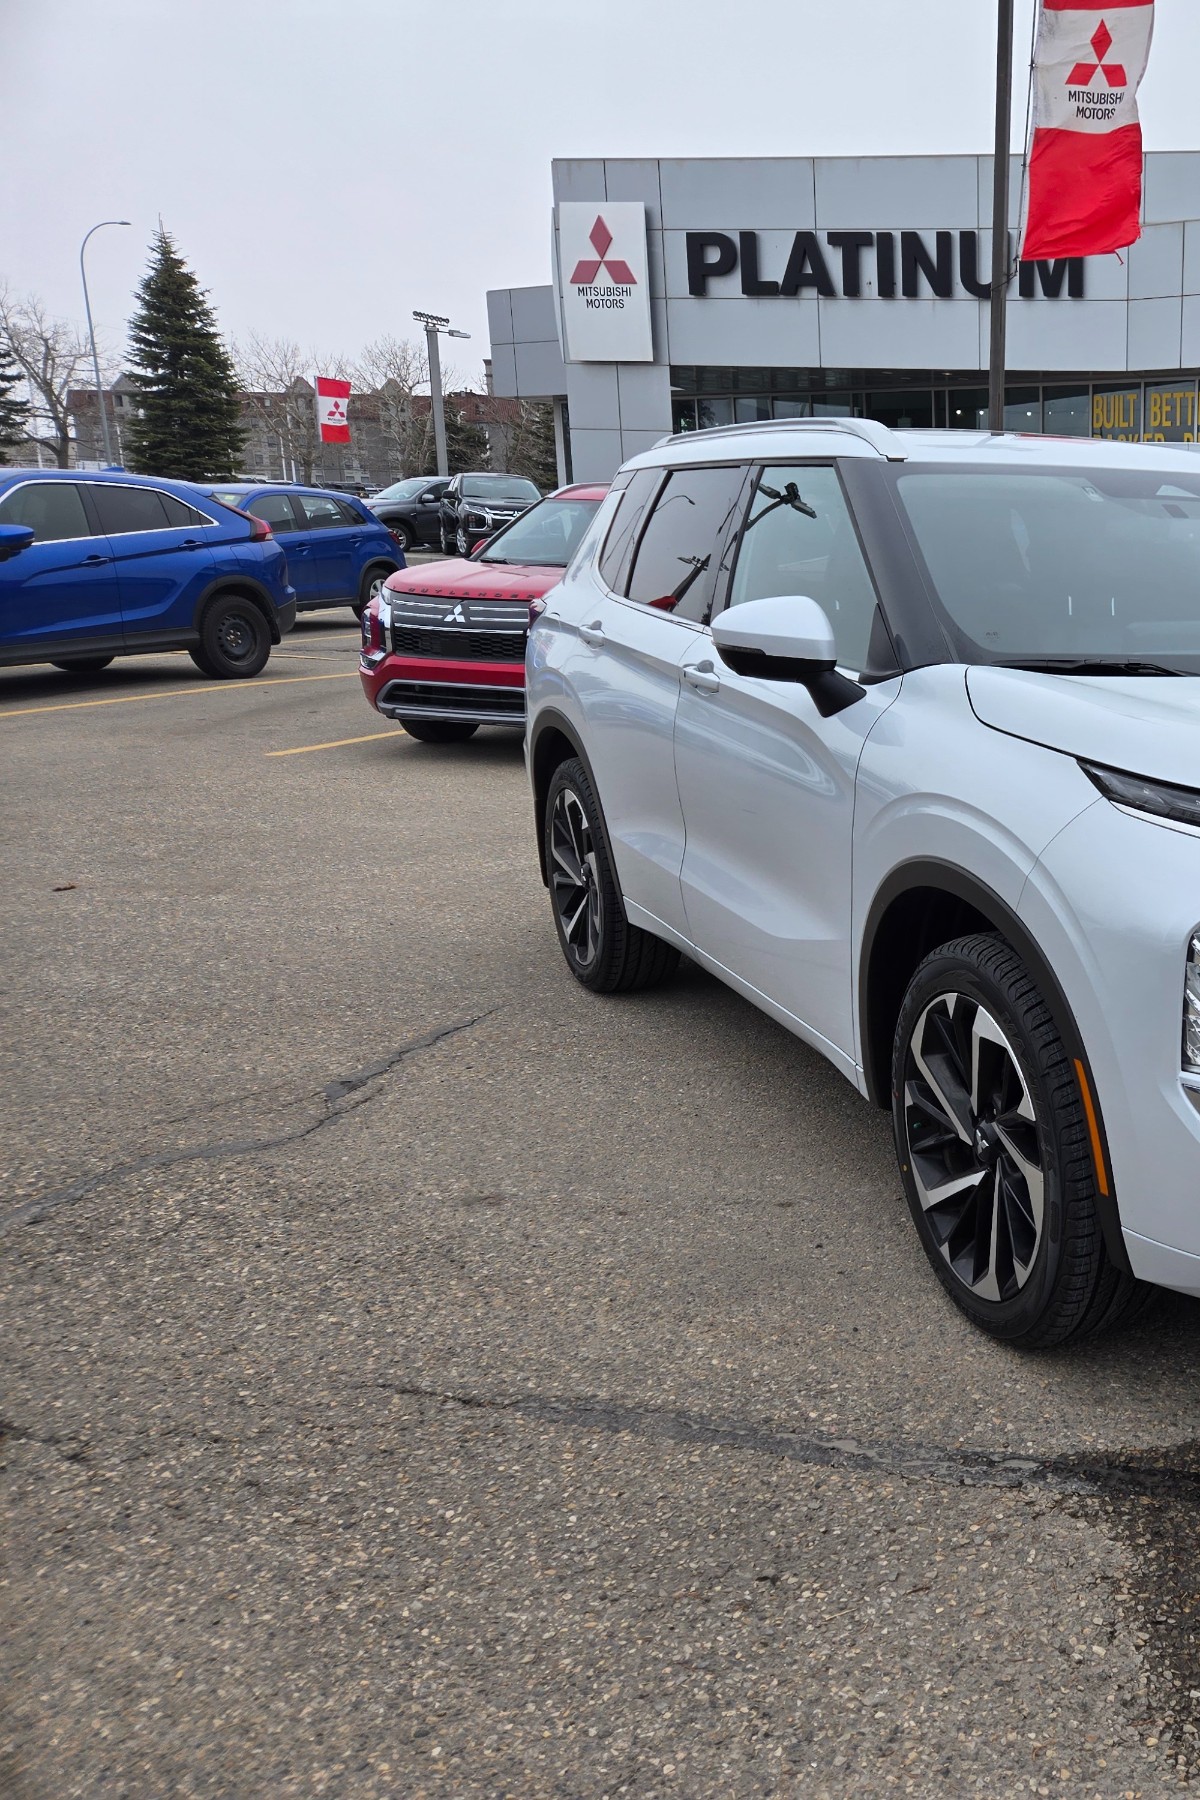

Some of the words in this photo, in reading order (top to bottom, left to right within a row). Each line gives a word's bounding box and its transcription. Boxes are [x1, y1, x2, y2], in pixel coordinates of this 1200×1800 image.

[1076, 106, 1116, 120] MOTORS
[686, 230, 1084, 299] PLATINUM
[577, 286, 632, 297] MITSUBISHI
[586, 298, 625, 309] MOTORS
[1093, 394, 1137, 429] BUILT
